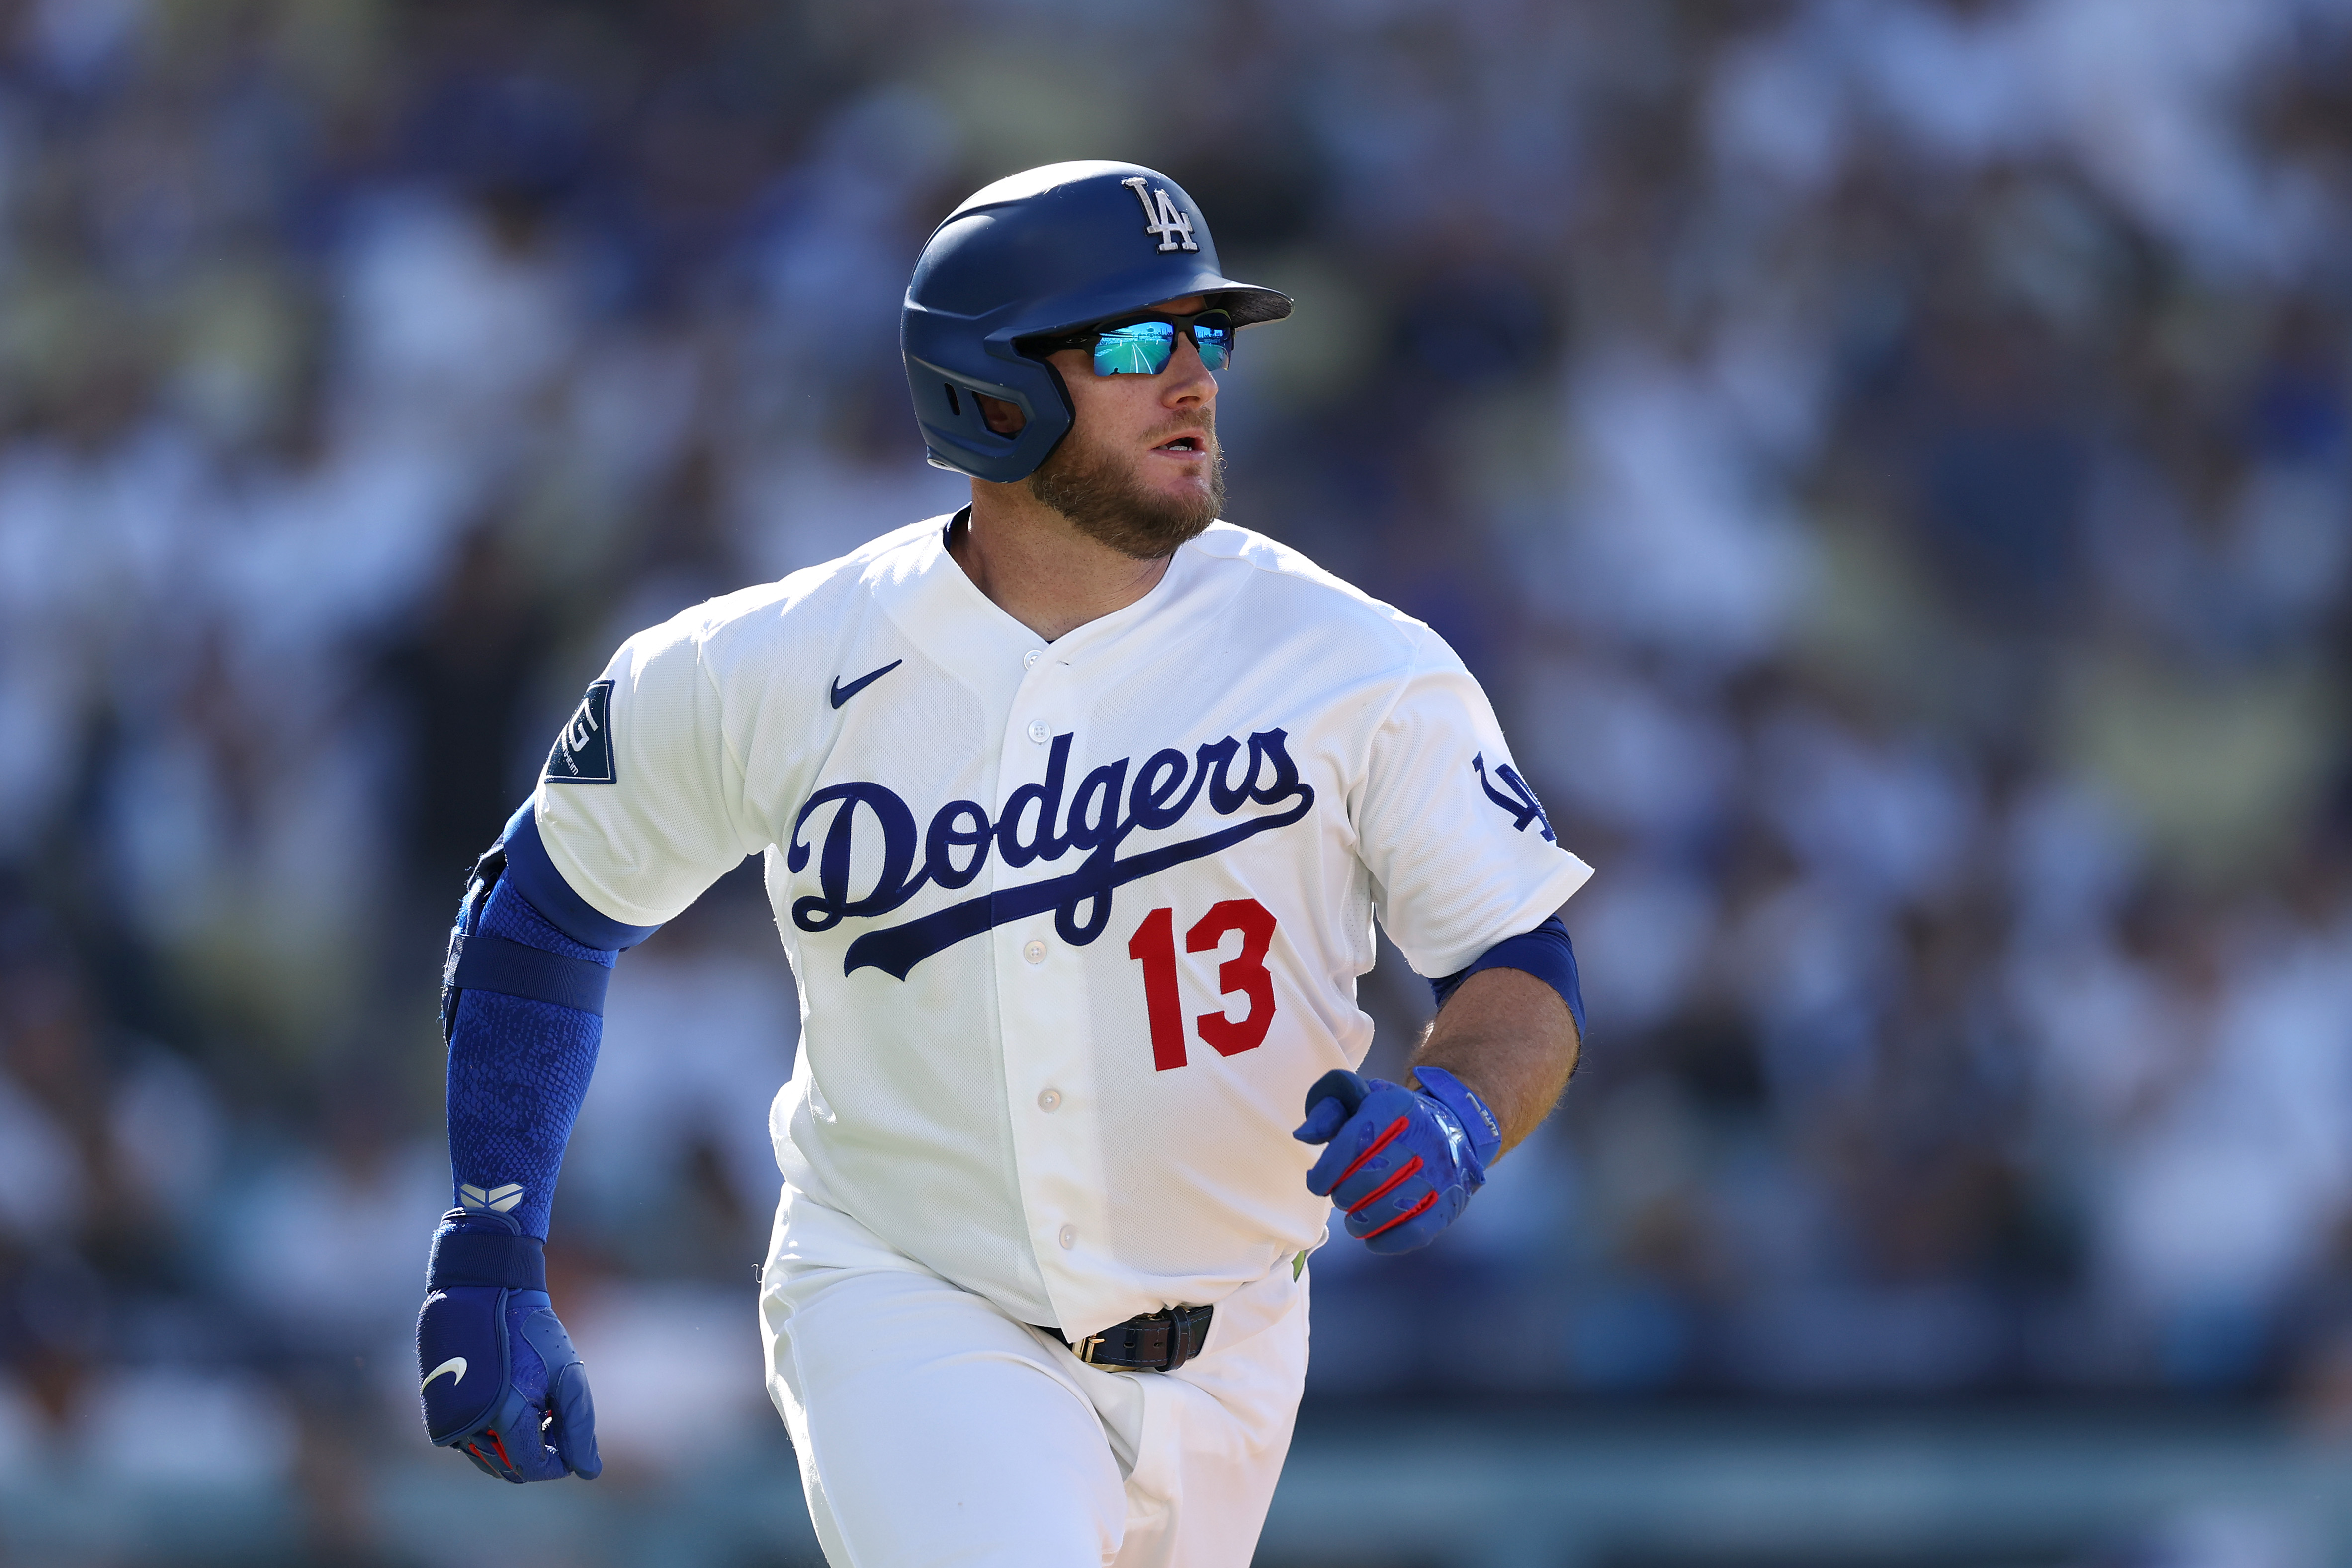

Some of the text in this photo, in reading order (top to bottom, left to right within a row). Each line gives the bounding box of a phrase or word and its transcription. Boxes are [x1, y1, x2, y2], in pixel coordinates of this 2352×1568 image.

[1121, 177, 1199, 252] LA
[788, 728, 1314, 947] Dodgers
[1129, 899, 1277, 1071] 13
